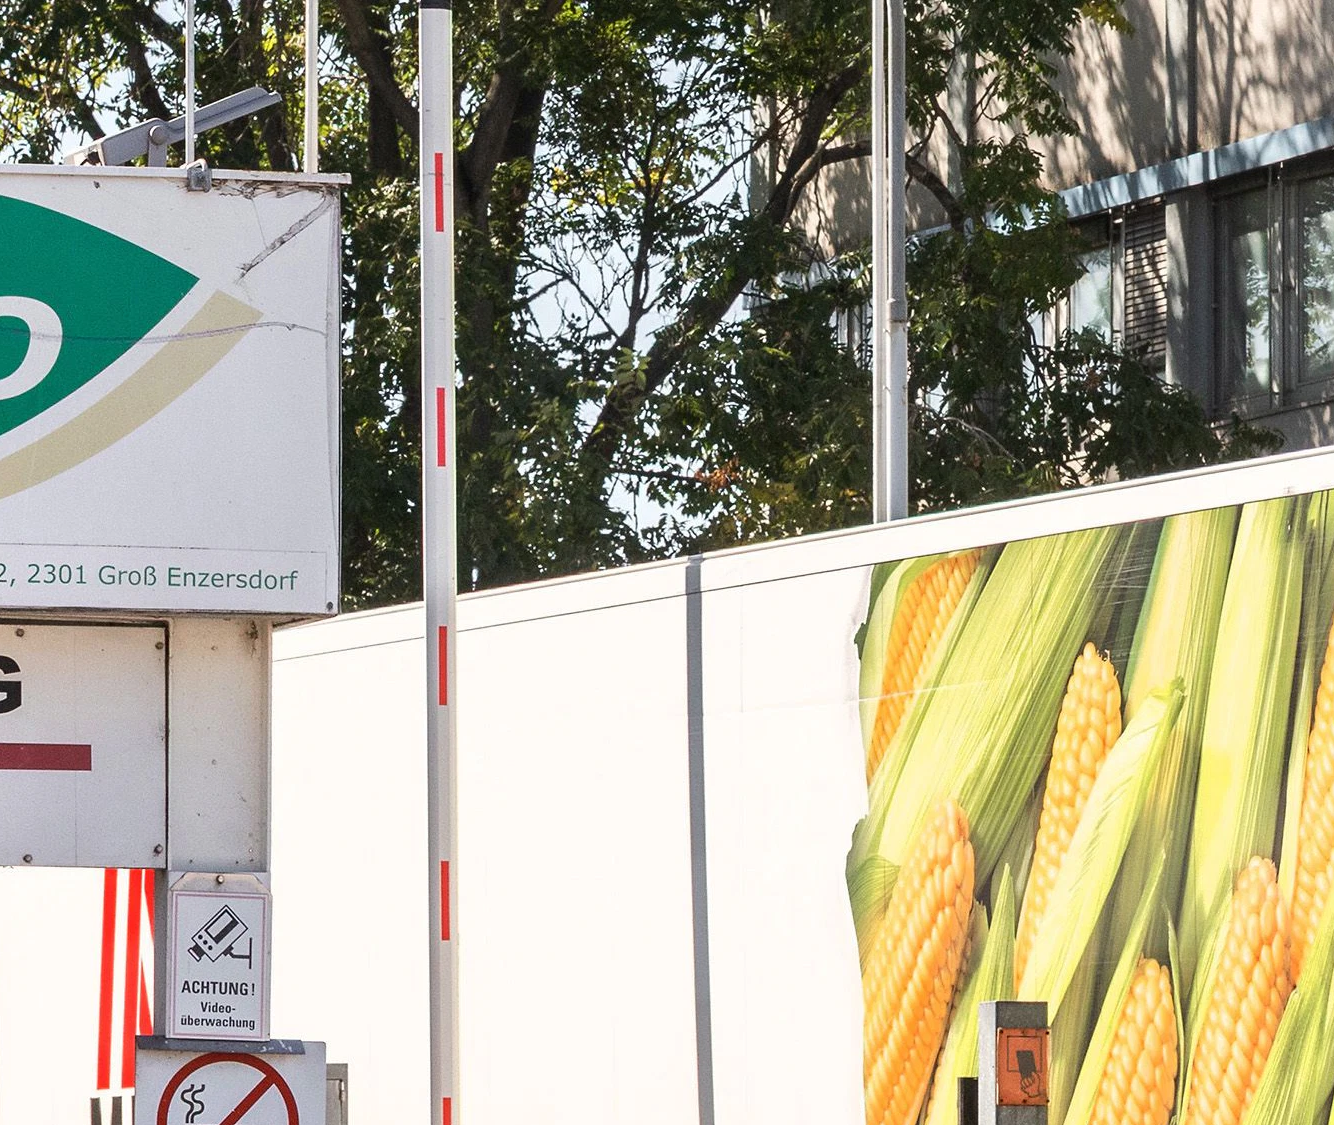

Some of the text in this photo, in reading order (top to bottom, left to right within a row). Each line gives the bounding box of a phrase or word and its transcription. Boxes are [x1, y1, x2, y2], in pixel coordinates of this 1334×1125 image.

[26, 562, 88, 586] 2301
[97, 565, 157, 588] Groß
[167, 566, 298, 592] Enzersdorf
[201, 1002, 235, 1013] Video-
[181, 1015, 255, 1030] überwachung
